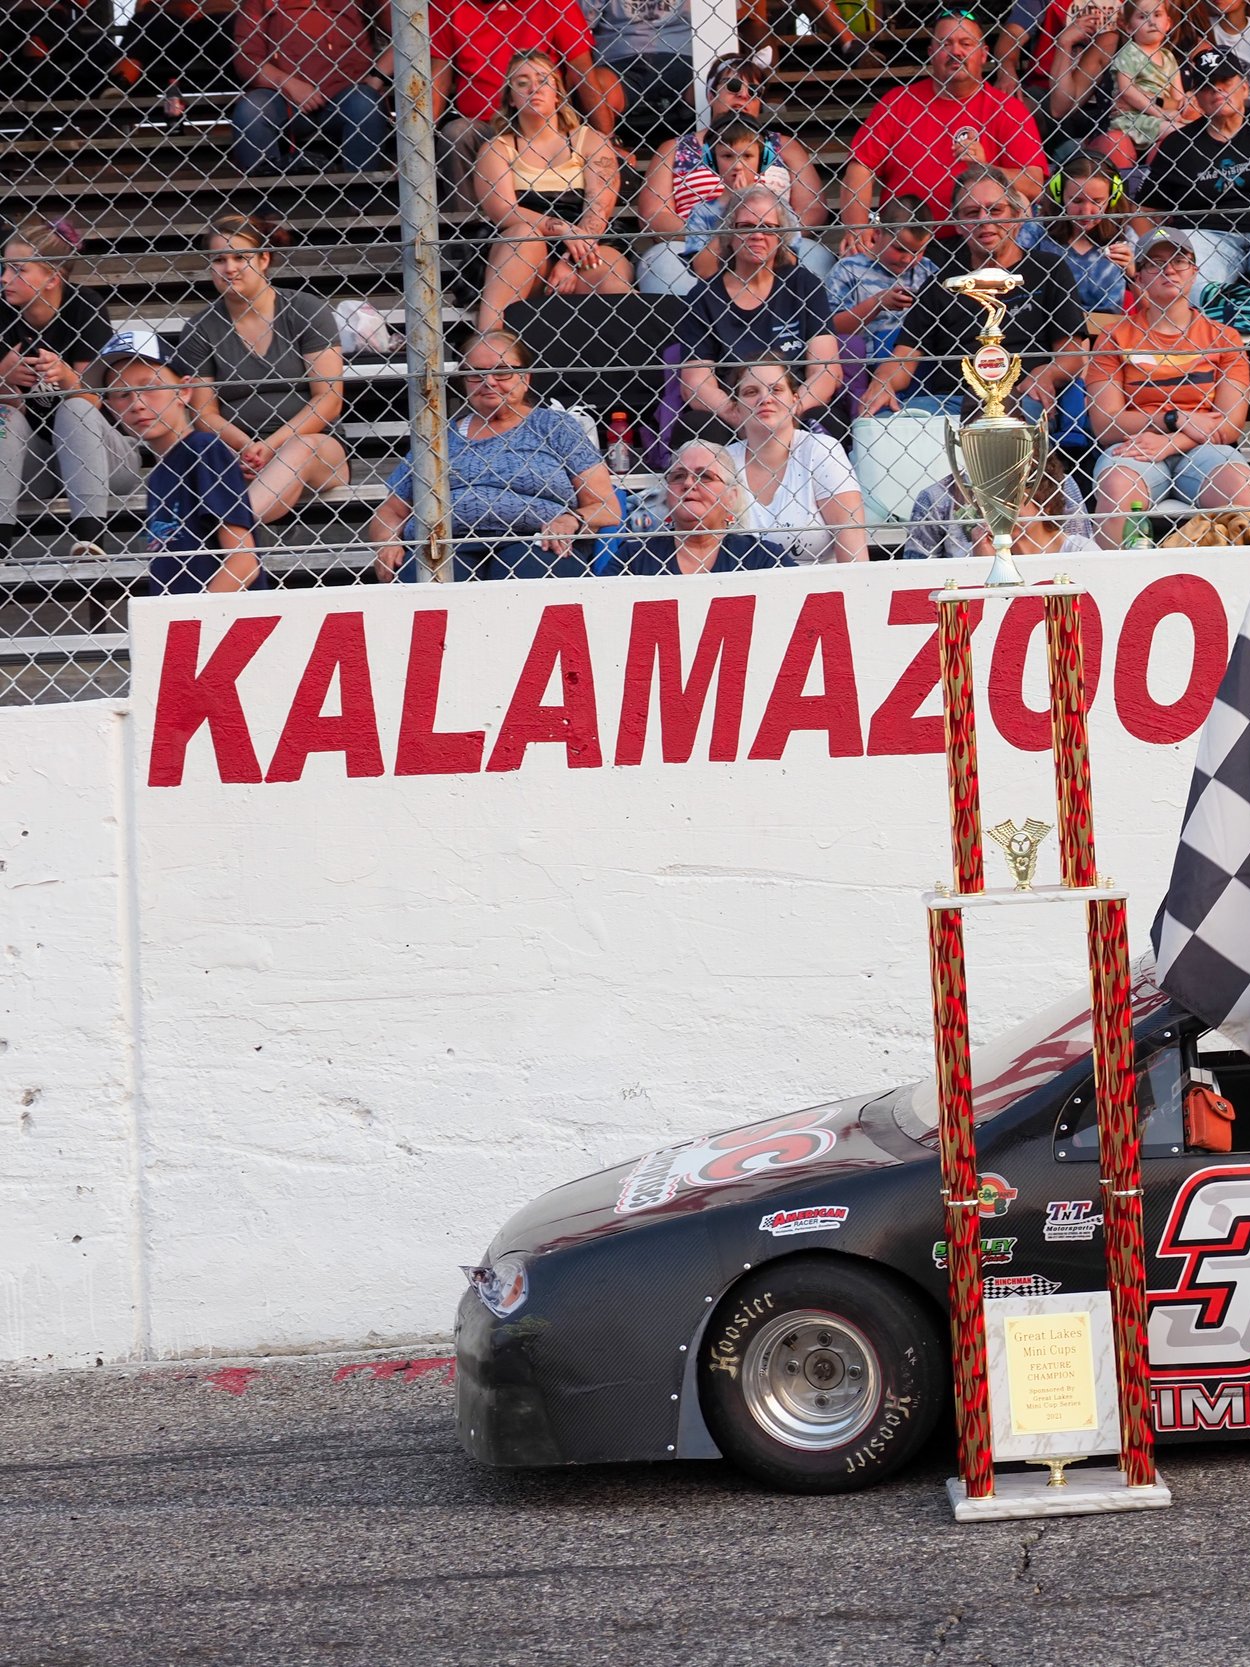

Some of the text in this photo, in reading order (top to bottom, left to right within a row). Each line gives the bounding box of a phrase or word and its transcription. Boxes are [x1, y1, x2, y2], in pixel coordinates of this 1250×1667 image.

[148, 573, 1228, 787] KALAMAZOO
[772, 1208, 847, 1228] AMERICAN
[793, 1219, 819, 1227] RACER
[994, 1277, 1032, 1286] HINCHMAN
[709, 1291, 773, 1380] Hoosier
[1014, 1329, 1082, 1343] Great Lakes
[1023, 1344, 1077, 1357] Mini Cups
[1030, 1361, 1072, 1371] FEATURE
[1027, 1371, 1075, 1381] CHAMPION
[1029, 1385, 1075, 1395] Sponsored By
[1043, 1402, 1058, 1410] Cup
[1060, 1400, 1081, 1408] Series
[846, 1387, 912, 1473] Hoosier
